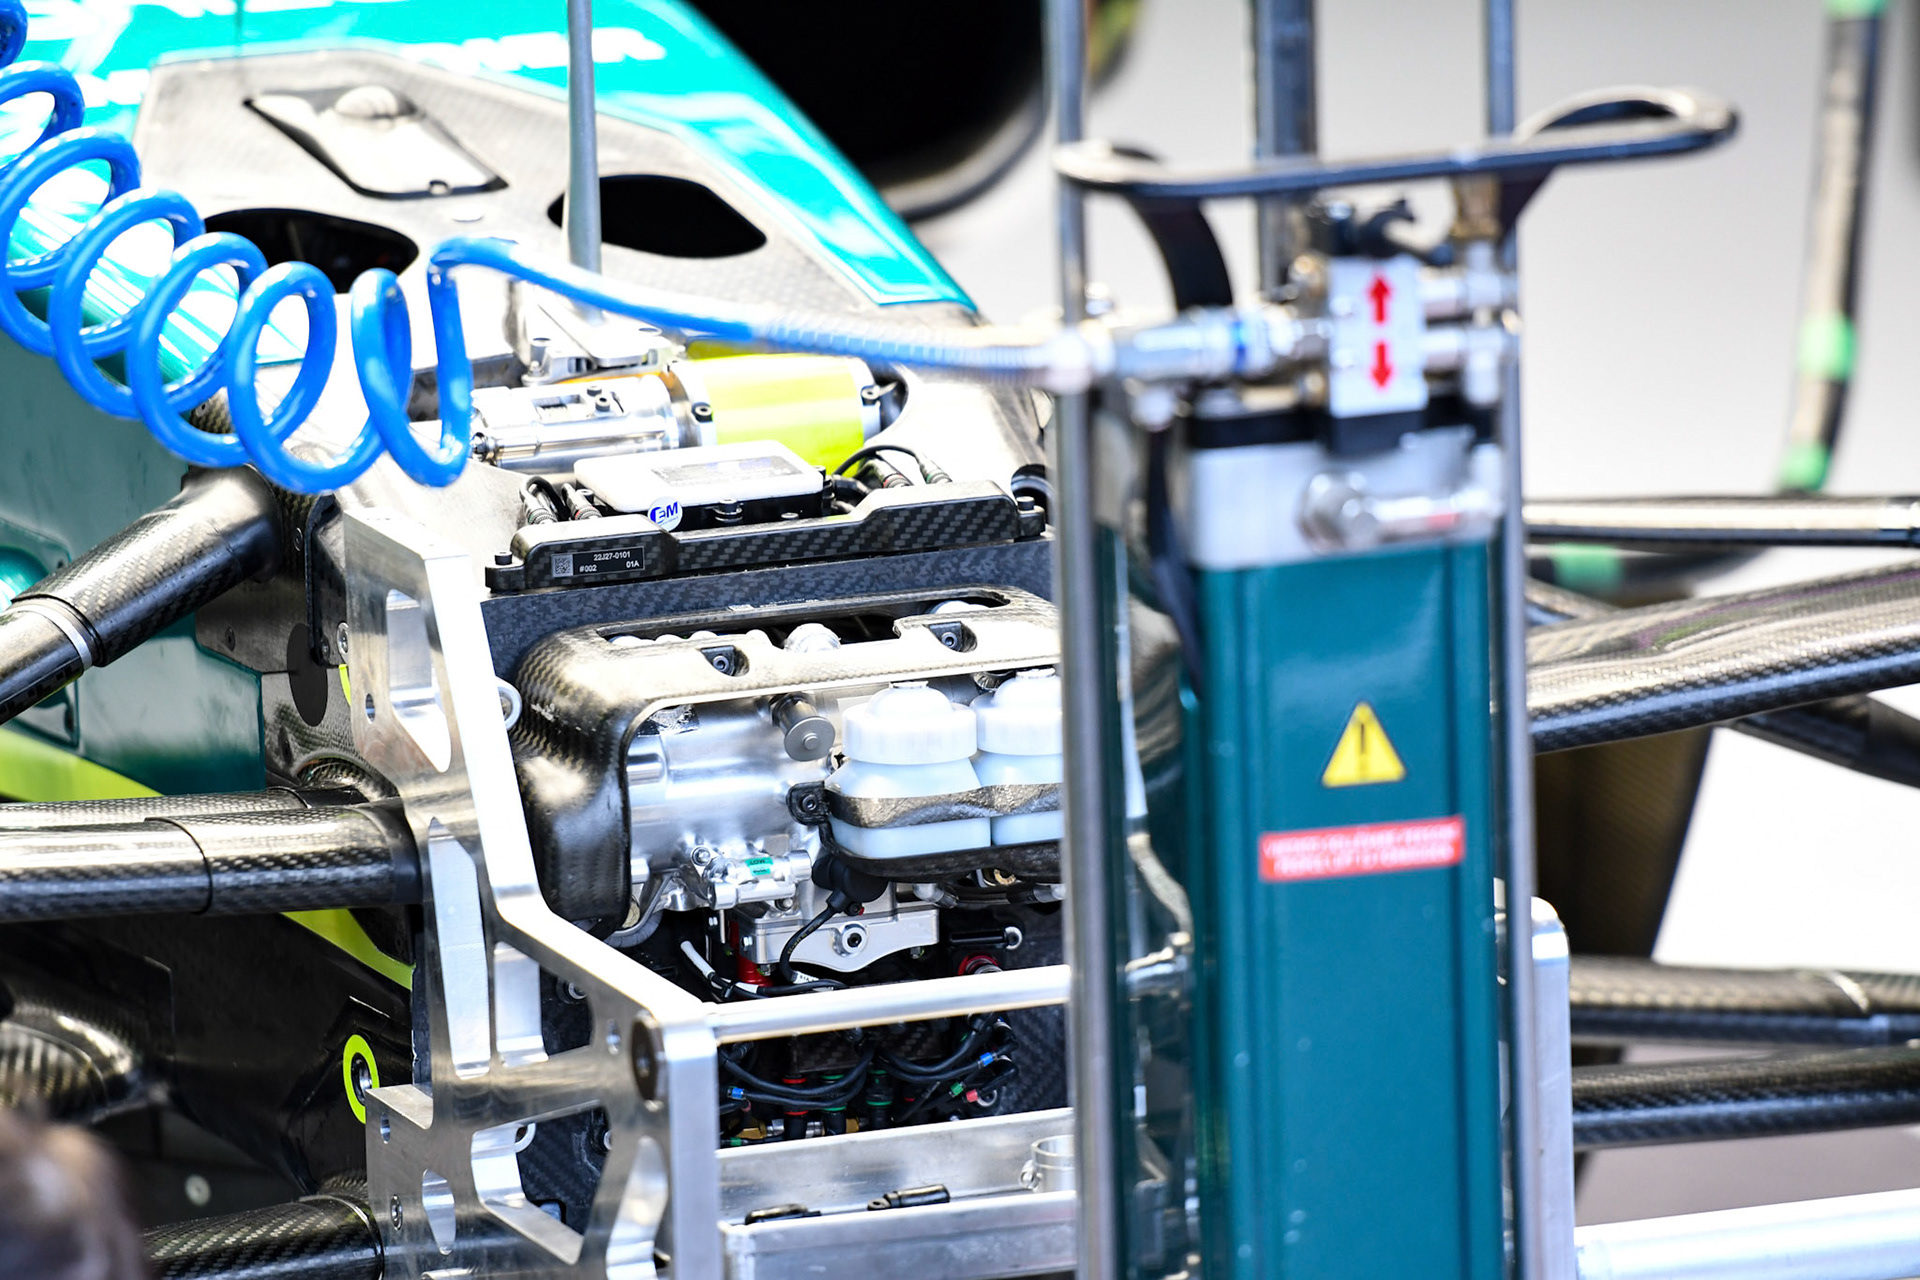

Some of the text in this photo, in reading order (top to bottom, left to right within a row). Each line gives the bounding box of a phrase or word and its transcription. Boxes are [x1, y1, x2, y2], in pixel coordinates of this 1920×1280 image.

[593, 551, 631, 561] 22J27-0101
[579, 564, 597, 573] #002
[626, 560, 640, 569] 01A
